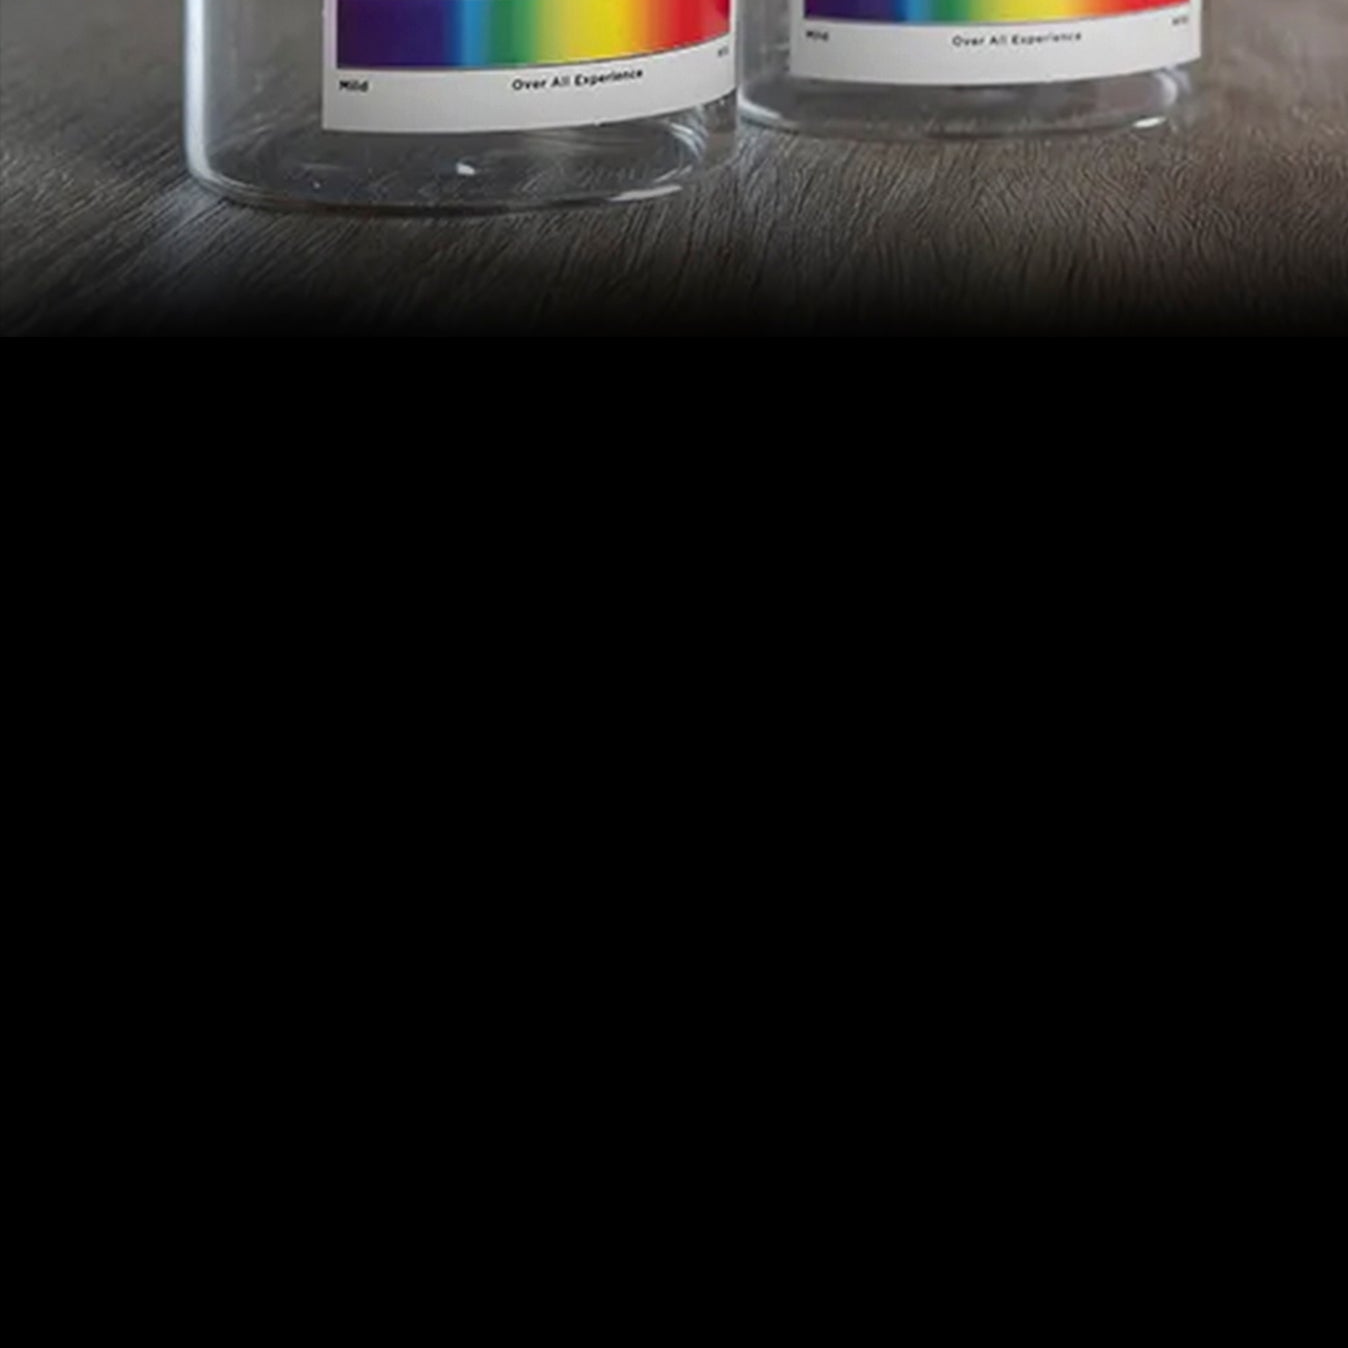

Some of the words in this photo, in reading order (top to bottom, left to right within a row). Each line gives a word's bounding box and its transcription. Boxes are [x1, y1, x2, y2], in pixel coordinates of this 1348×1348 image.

[952, 35, 985, 47] Over
[1011, 31, 1082, 46] Experience
[339, 80, 369, 93] Mild
[512, 77, 546, 91] Over
[551, 75, 570, 89] All
[574, 67, 644, 88] Experience
